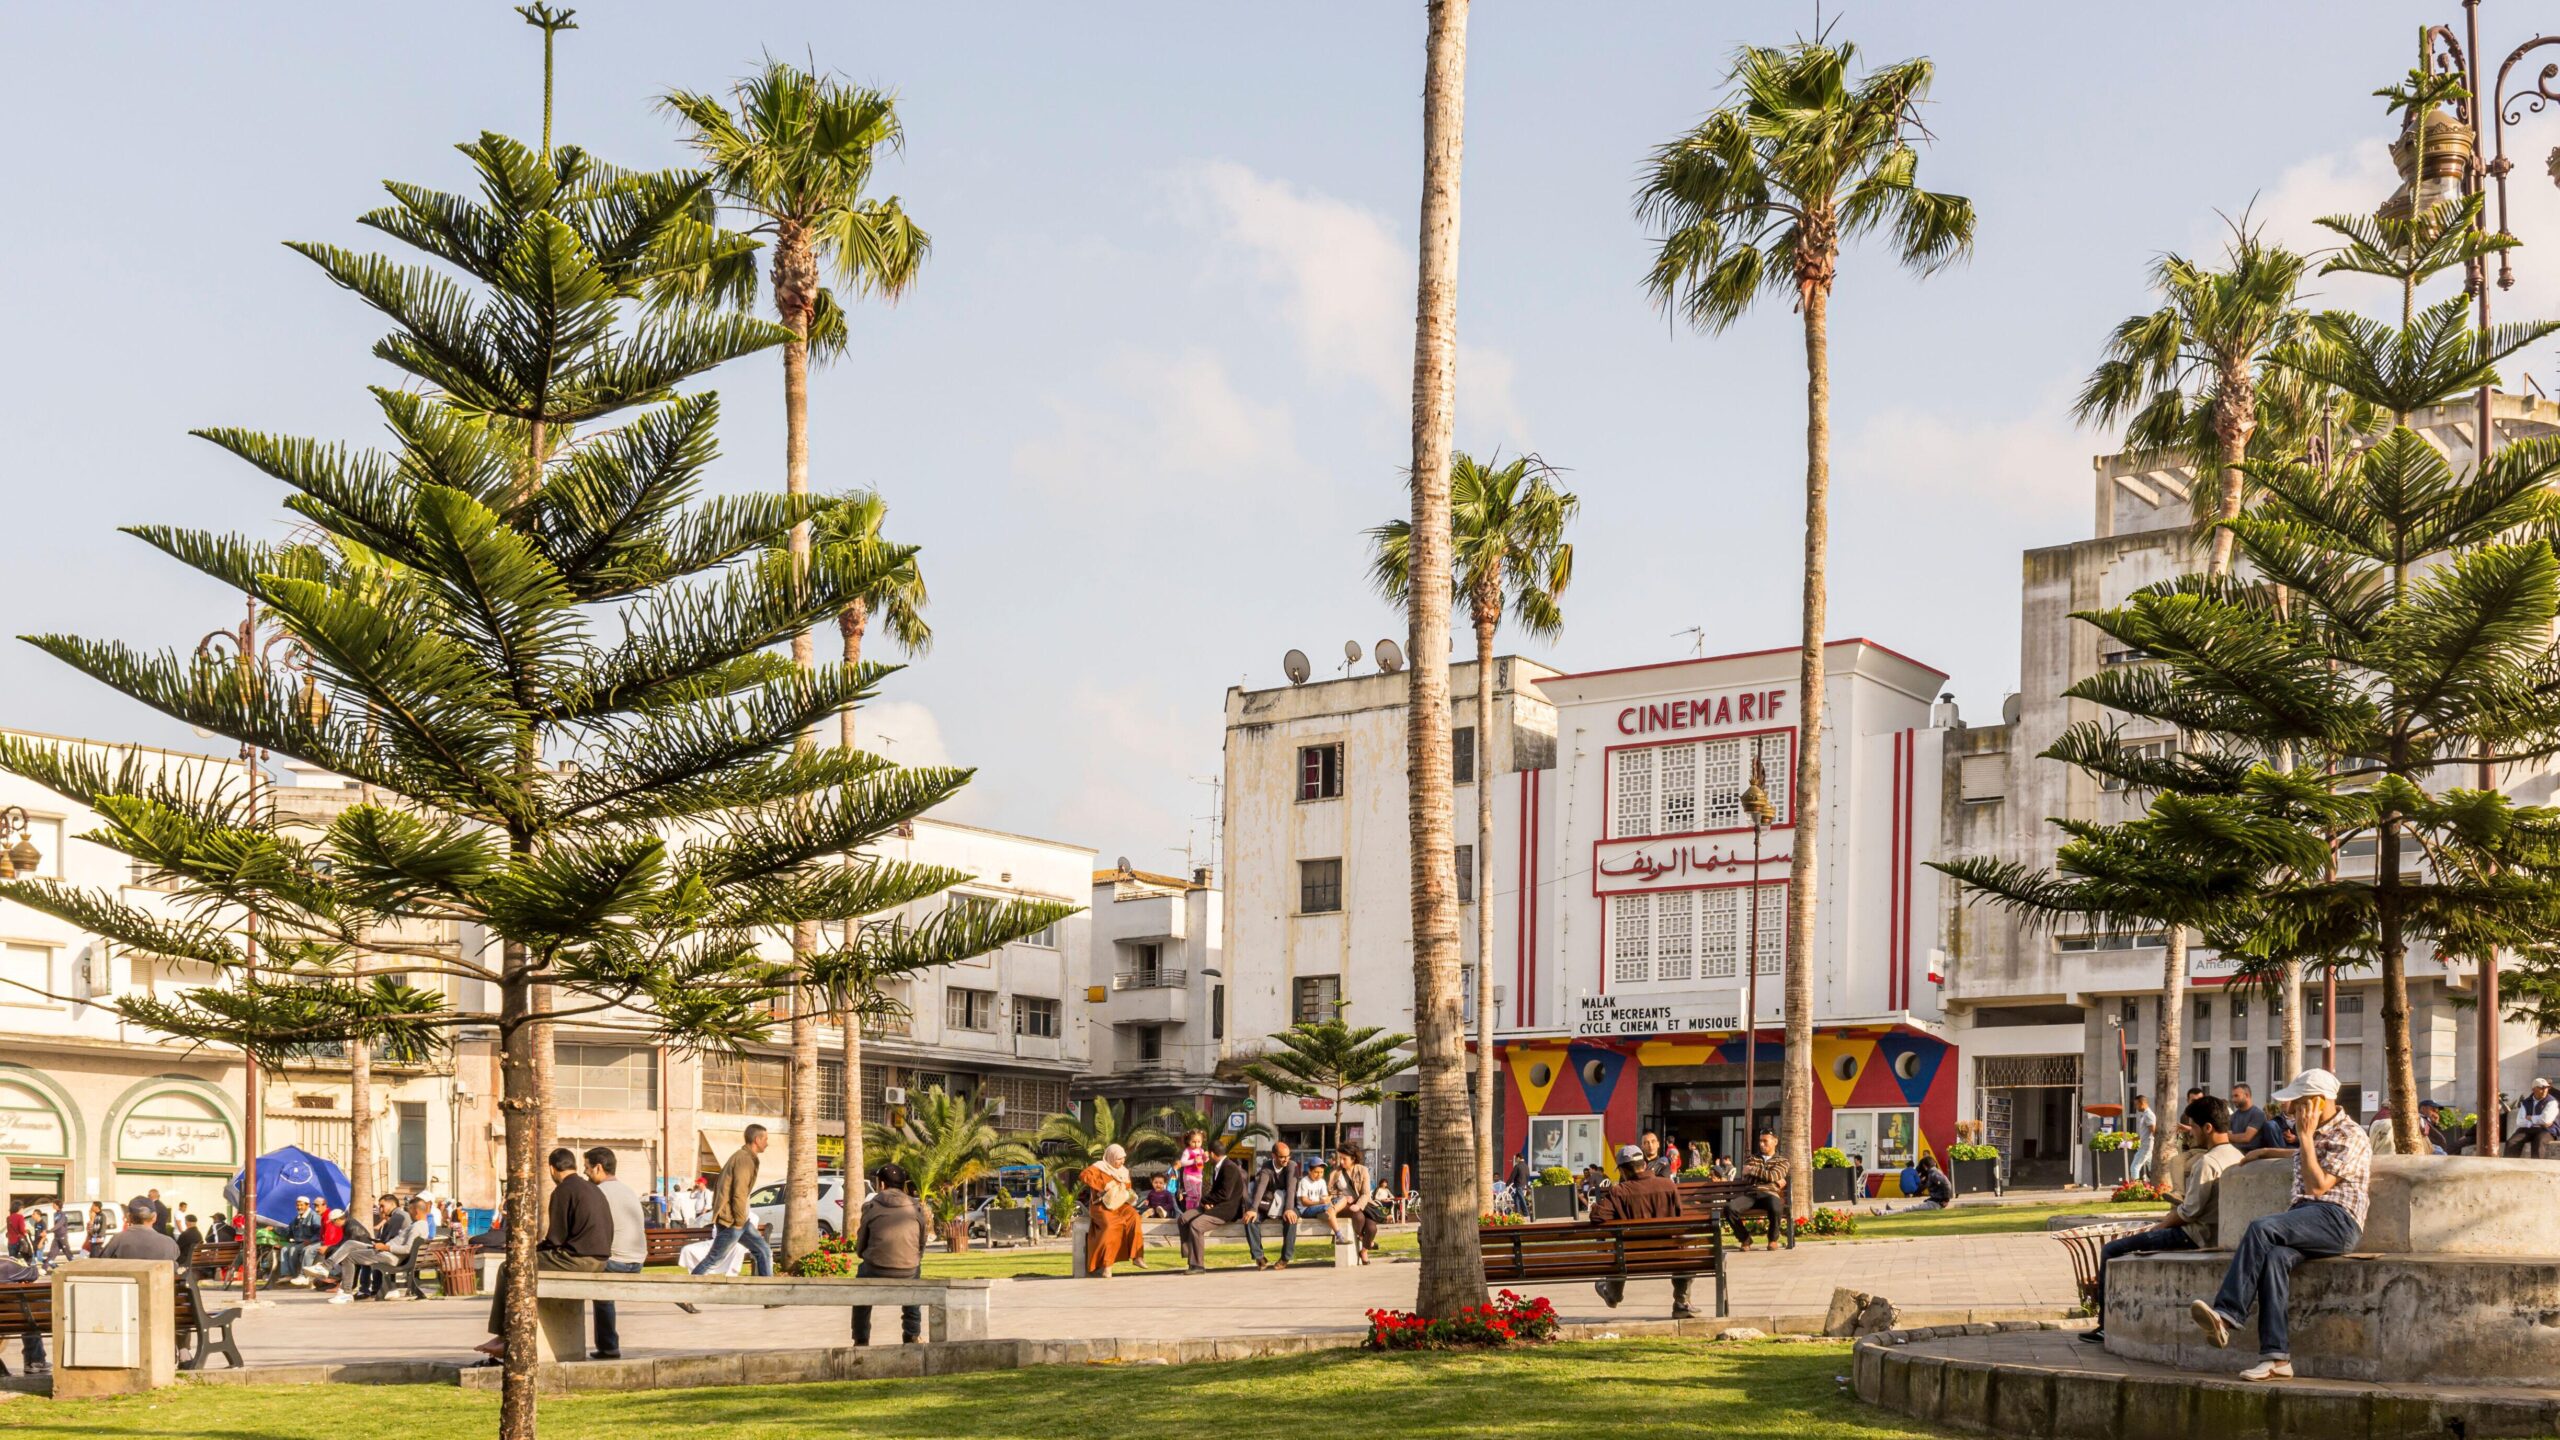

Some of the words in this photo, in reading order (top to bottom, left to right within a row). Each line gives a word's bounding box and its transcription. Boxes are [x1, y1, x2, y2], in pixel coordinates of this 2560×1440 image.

[1618, 696, 1732, 735] CINEMA
[1739, 690, 1786, 722] RIF
[1600, 847, 1688, 882] الريف
[1582, 997, 1616, 1009] MALAK
[1587, 1009, 1604, 1021] LES
[1611, 1007, 1671, 1020] MECREANTS
[1580, 1023, 1611, 1034] CYCLE
[1620, 1020, 1658, 1032] CINEMA
[1668, 1019, 1680, 1031] ET
[1689, 1017, 1738, 1029] MUSIQUE
